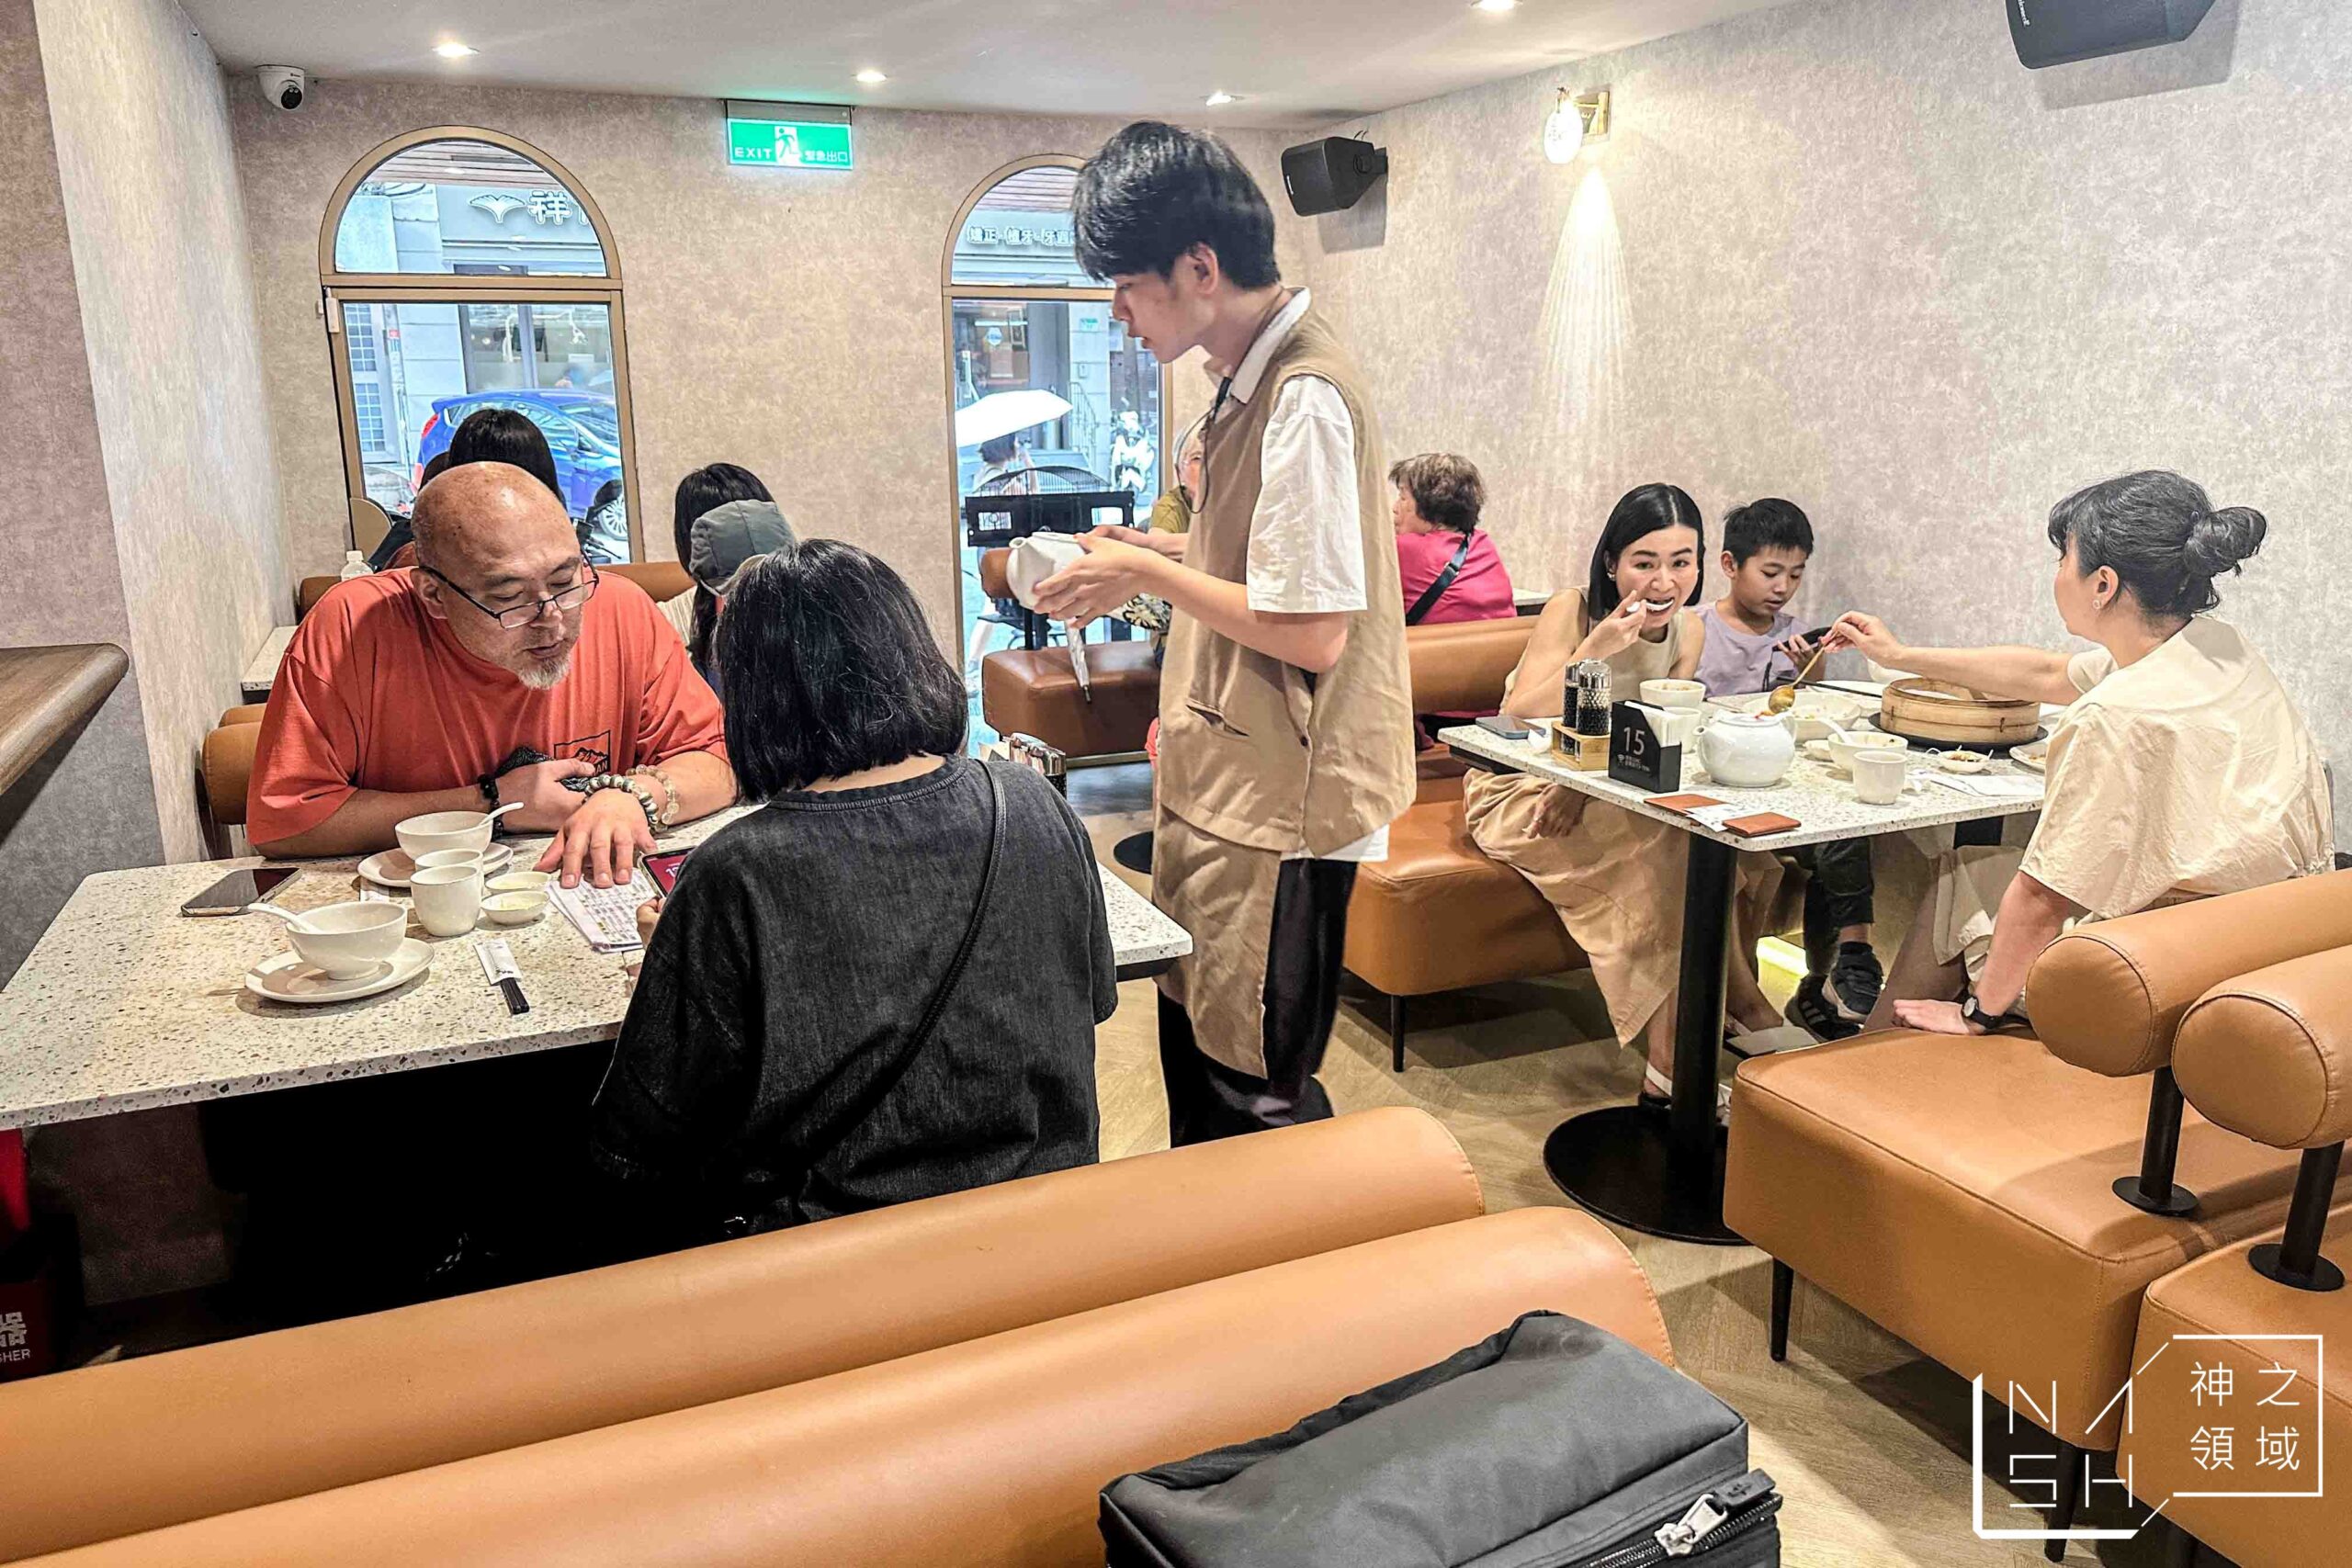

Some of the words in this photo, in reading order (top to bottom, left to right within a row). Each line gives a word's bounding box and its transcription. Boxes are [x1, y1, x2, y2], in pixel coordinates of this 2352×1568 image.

[735, 147, 772, 159] EXIT
[805, 150, 848, 163] 緊急出口
[527, 190, 589, 225] 祥
[1623, 727, 1645, 756] 15
[0, 1348, 31, 1363] HER
